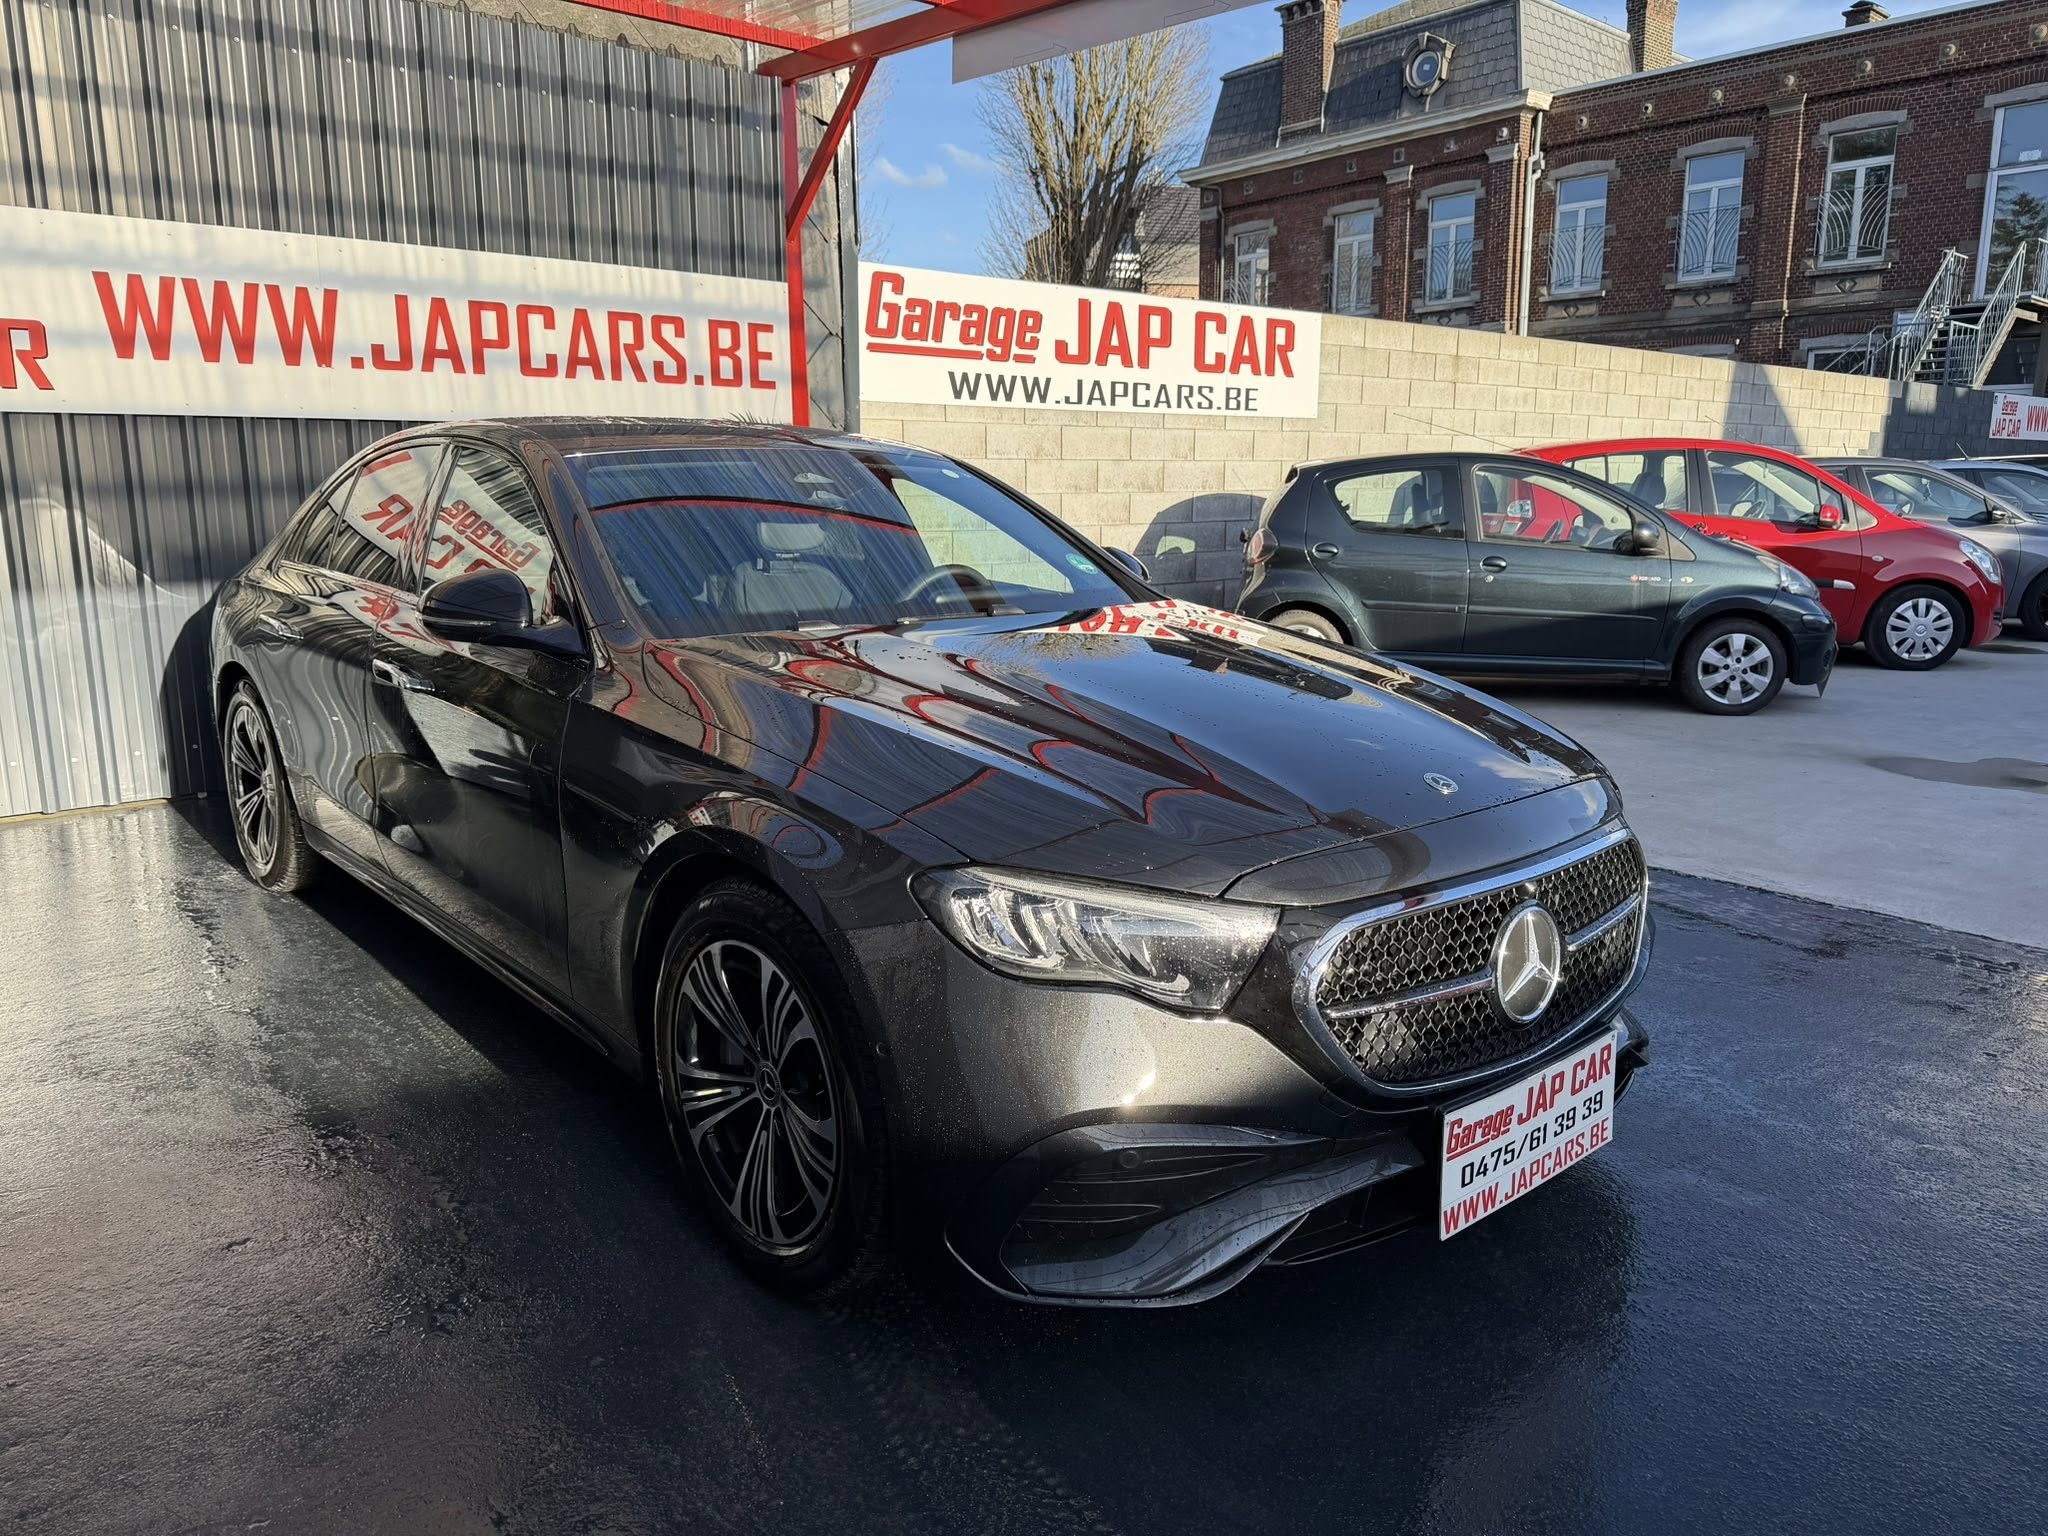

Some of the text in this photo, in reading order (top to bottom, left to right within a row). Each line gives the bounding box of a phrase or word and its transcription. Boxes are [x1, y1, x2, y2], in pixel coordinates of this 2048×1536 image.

[92, 271, 777, 391] WWW.JAPCARS.BE
[865, 270, 1296, 378] Garage JAP CAR
[948, 370, 1259, 412] WWW.JAPCARS.BE
[1446, 1043, 1612, 1158] Garage JAP CAR
[1461, 1090, 1604, 1189] 0475/61 39 39
[1443, 1116, 1610, 1236] WWW.JAPCARS.BE
